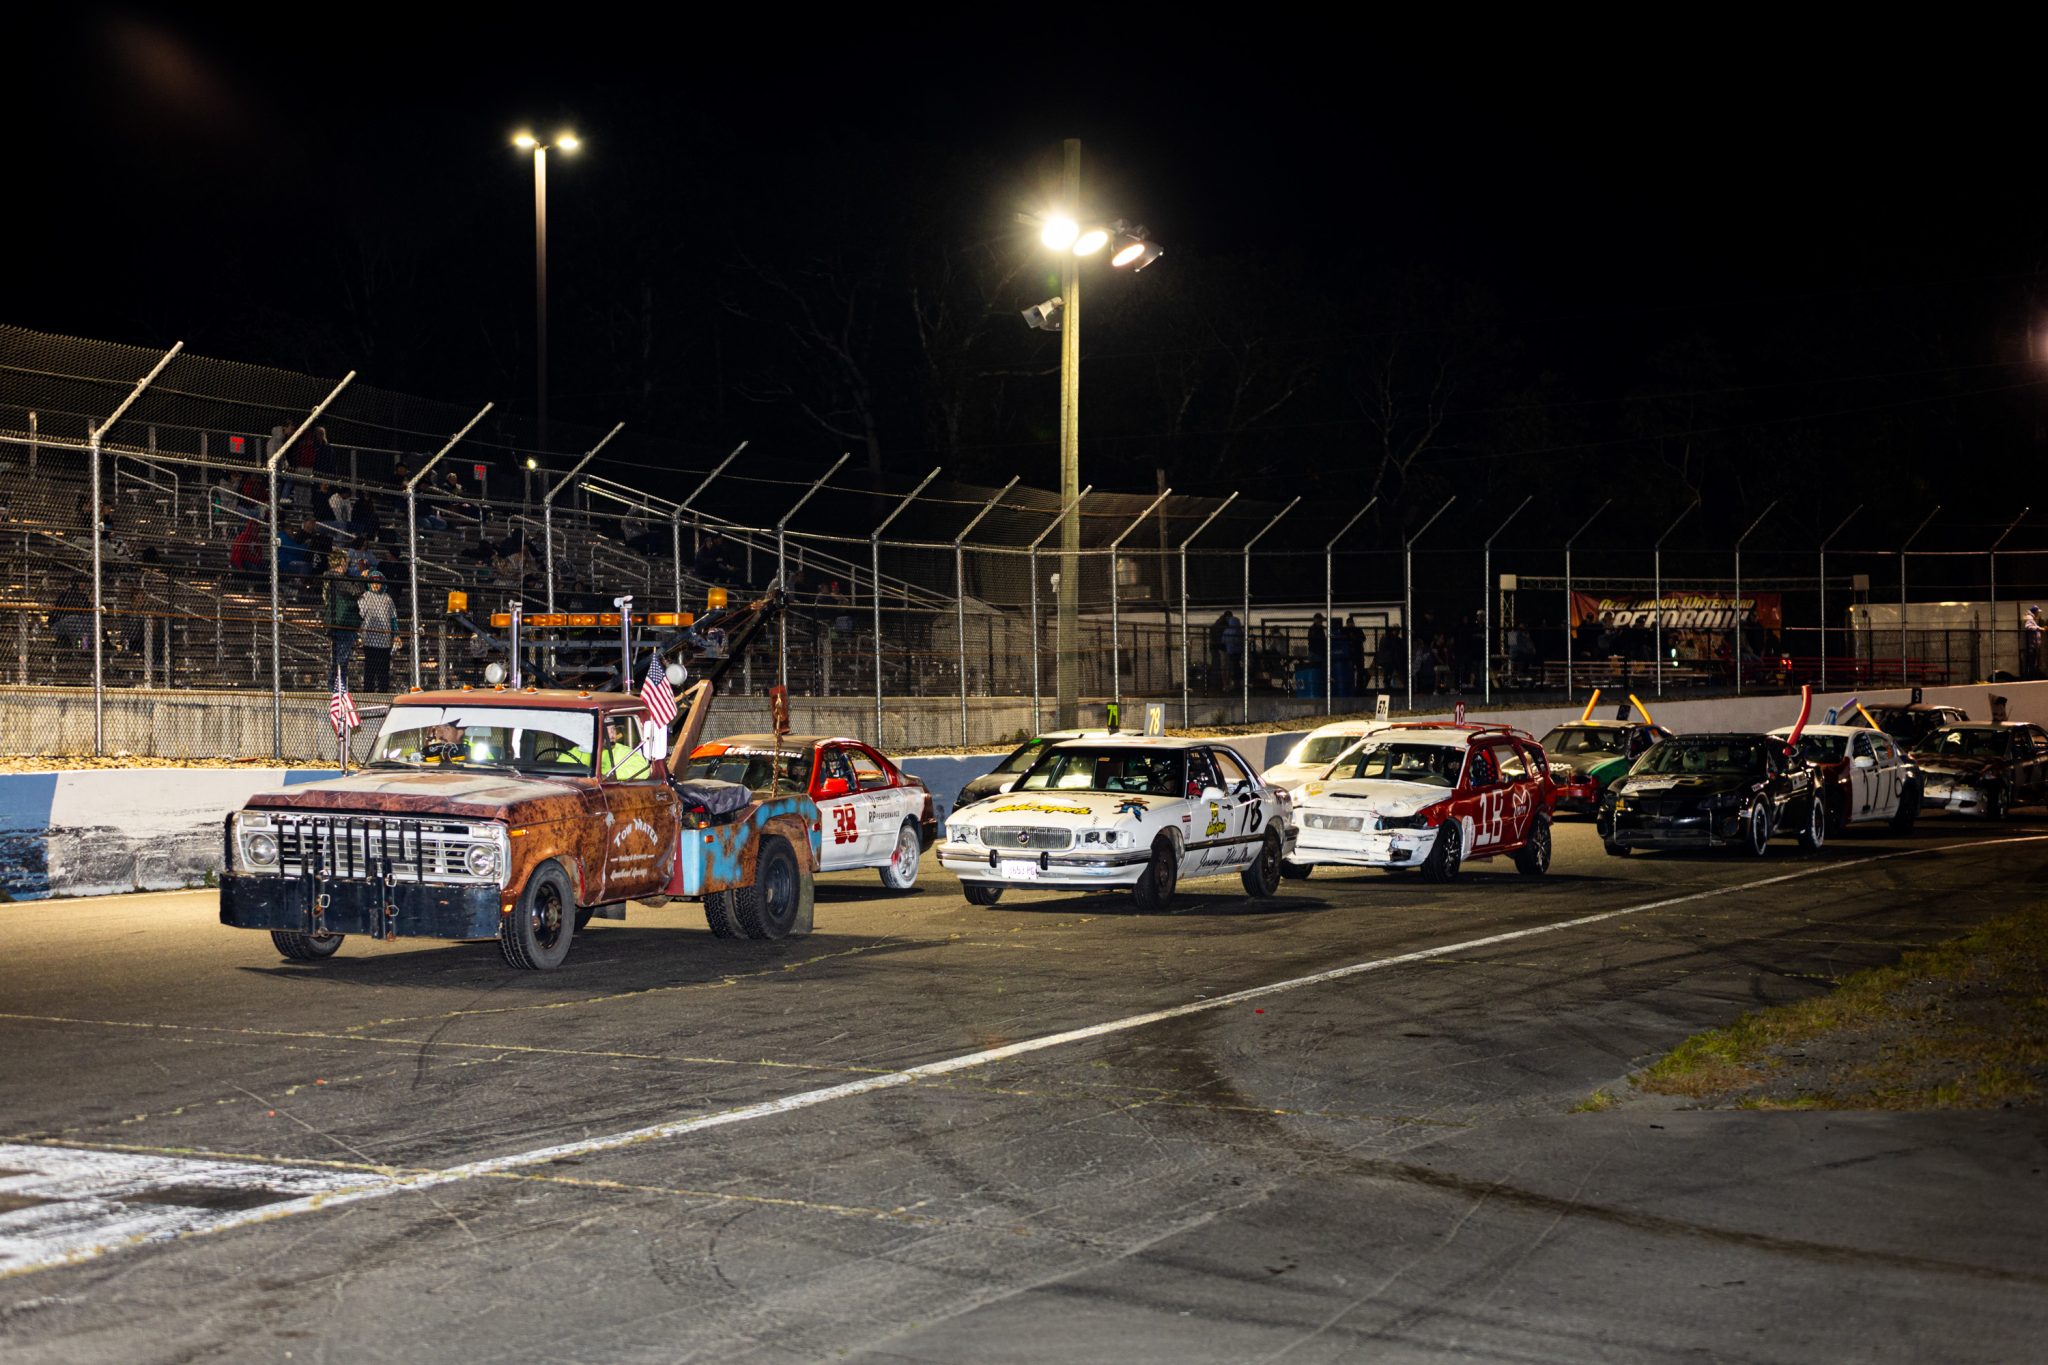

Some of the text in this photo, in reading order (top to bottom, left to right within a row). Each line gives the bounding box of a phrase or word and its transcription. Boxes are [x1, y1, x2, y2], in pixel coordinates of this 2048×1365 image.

[1148, 706, 1161, 736] 78
[1455, 704, 1465, 726] 18
[833, 803, 859, 845] 38
[1238, 792, 1262, 836] 78
[1475, 788, 1504, 846] 18
